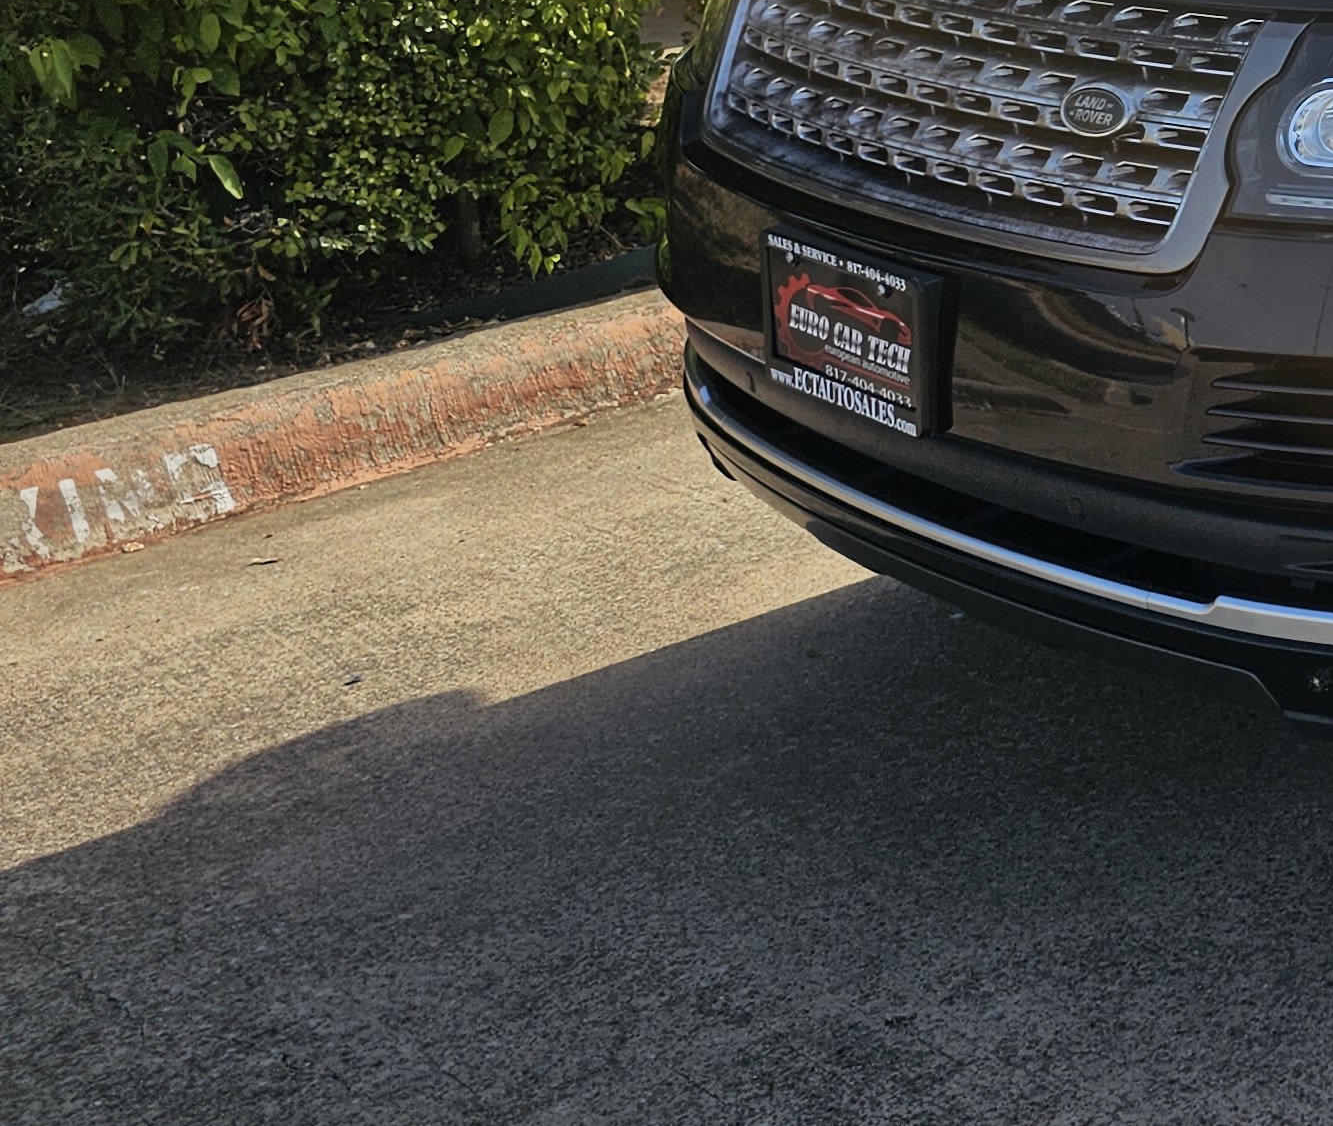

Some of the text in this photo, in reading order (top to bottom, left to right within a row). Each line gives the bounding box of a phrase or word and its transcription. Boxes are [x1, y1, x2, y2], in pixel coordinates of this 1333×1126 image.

[1073, 108, 1113, 126] ROVER
[1074, 94, 1107, 111] LAND
[767, 233, 793, 252] SALES
[801, 244, 837, 267] SERVICE
[846, 260, 906, 291] 817-404-4033
[789, 303, 912, 374] EURO CAR TECH
[769, 366, 917, 437] www.ECTAUTOSALES.com
